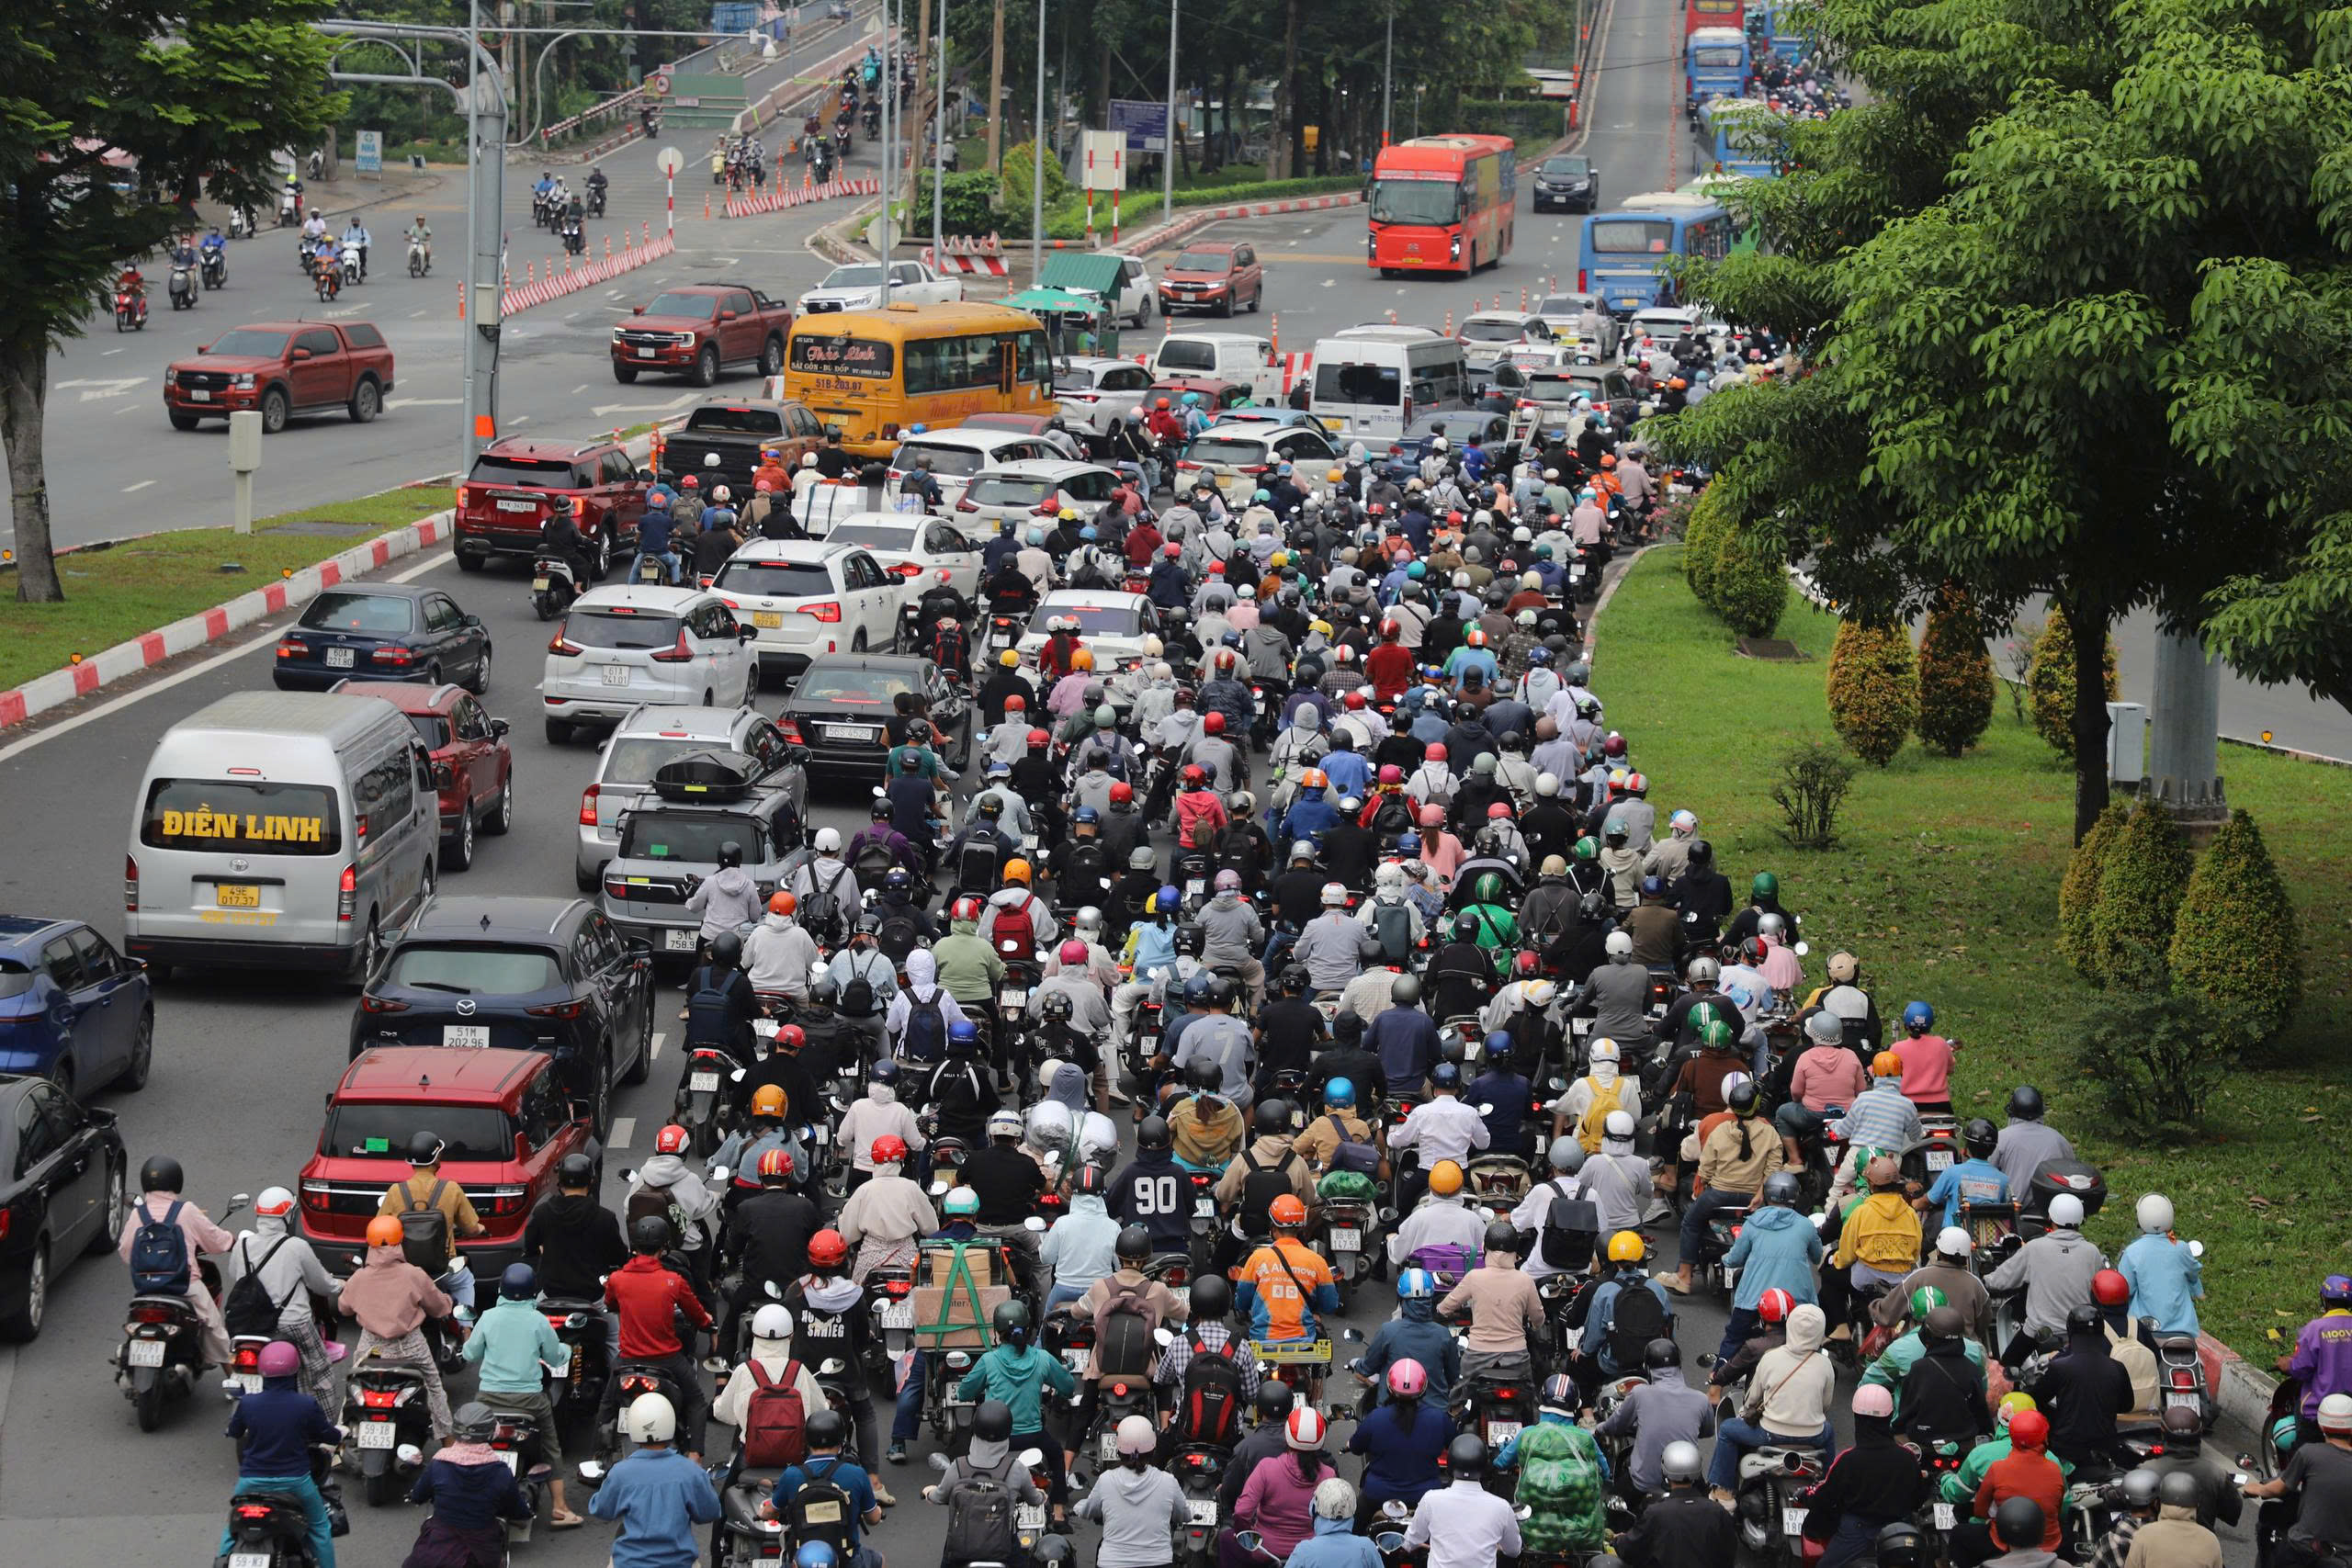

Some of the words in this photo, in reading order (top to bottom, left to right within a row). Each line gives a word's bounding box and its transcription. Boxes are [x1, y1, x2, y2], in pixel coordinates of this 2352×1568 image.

[816, 378, 862, 390] 51B-203.07
[334, 648, 347, 657] 60A
[608, 665, 623, 675] 61A
[604, 674, 627, 684] 741.01
[163, 804, 238, 839] ĐIỀN
[245, 814, 322, 843] LINH
[229, 886, 248, 897] 49E
[221, 896, 254, 906] 017.37
[457, 1027, 477, 1037] 51M
[449, 1037, 484, 1048] 202.96
[1213, 1030, 1237, 1066] 7
[1134, 1176, 1177, 1215] 90
[1333, 1241, 1359, 1250] 147.59
[882, 1317, 911, 1327] 619.13
[361, 1436, 390, 1446] 545.25
